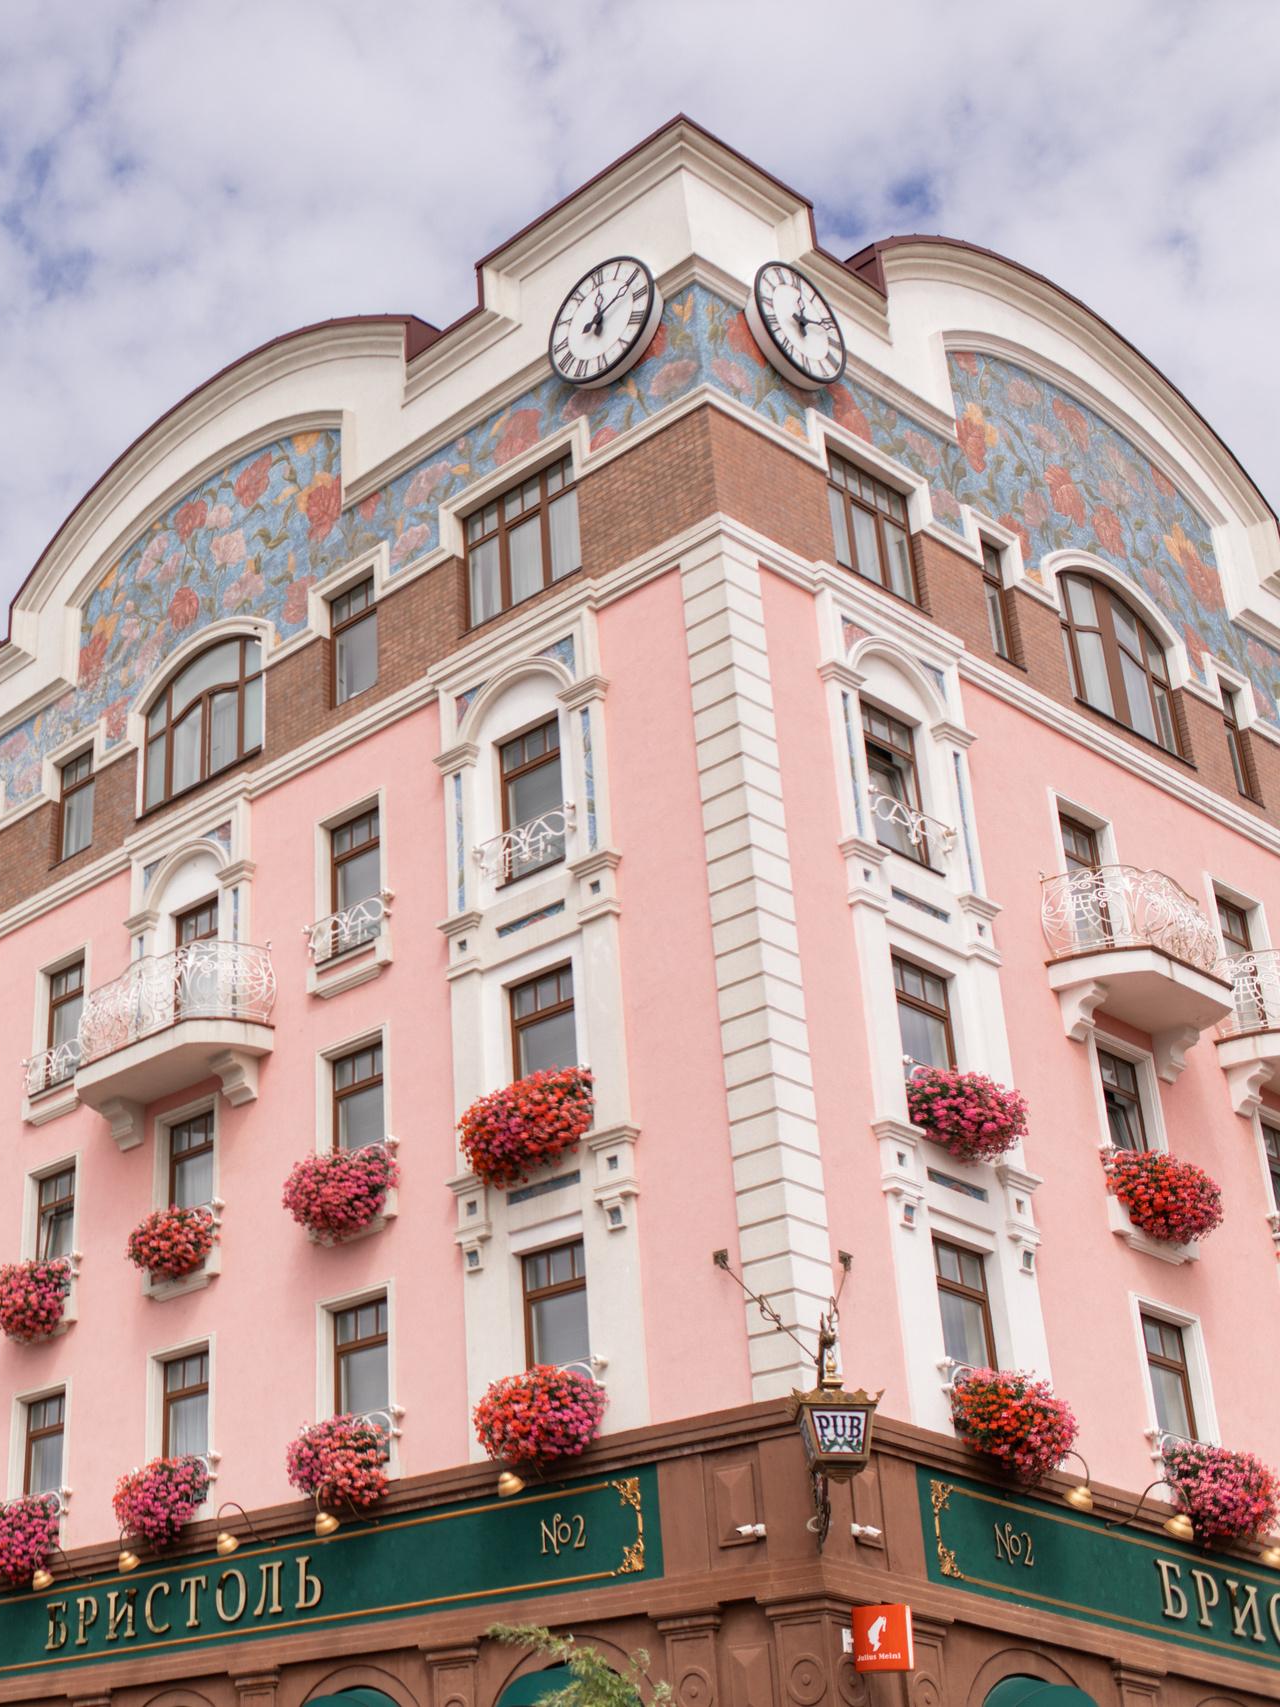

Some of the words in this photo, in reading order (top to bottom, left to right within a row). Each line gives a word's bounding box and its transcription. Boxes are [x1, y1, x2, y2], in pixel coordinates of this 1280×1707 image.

[815, 1414, 862, 1438] PUB
[45, 1556, 323, 1651] БРИСТОЛЬ
[857, 1653, 877, 1662] Julius
[878, 1652, 901, 1660] Meinl
